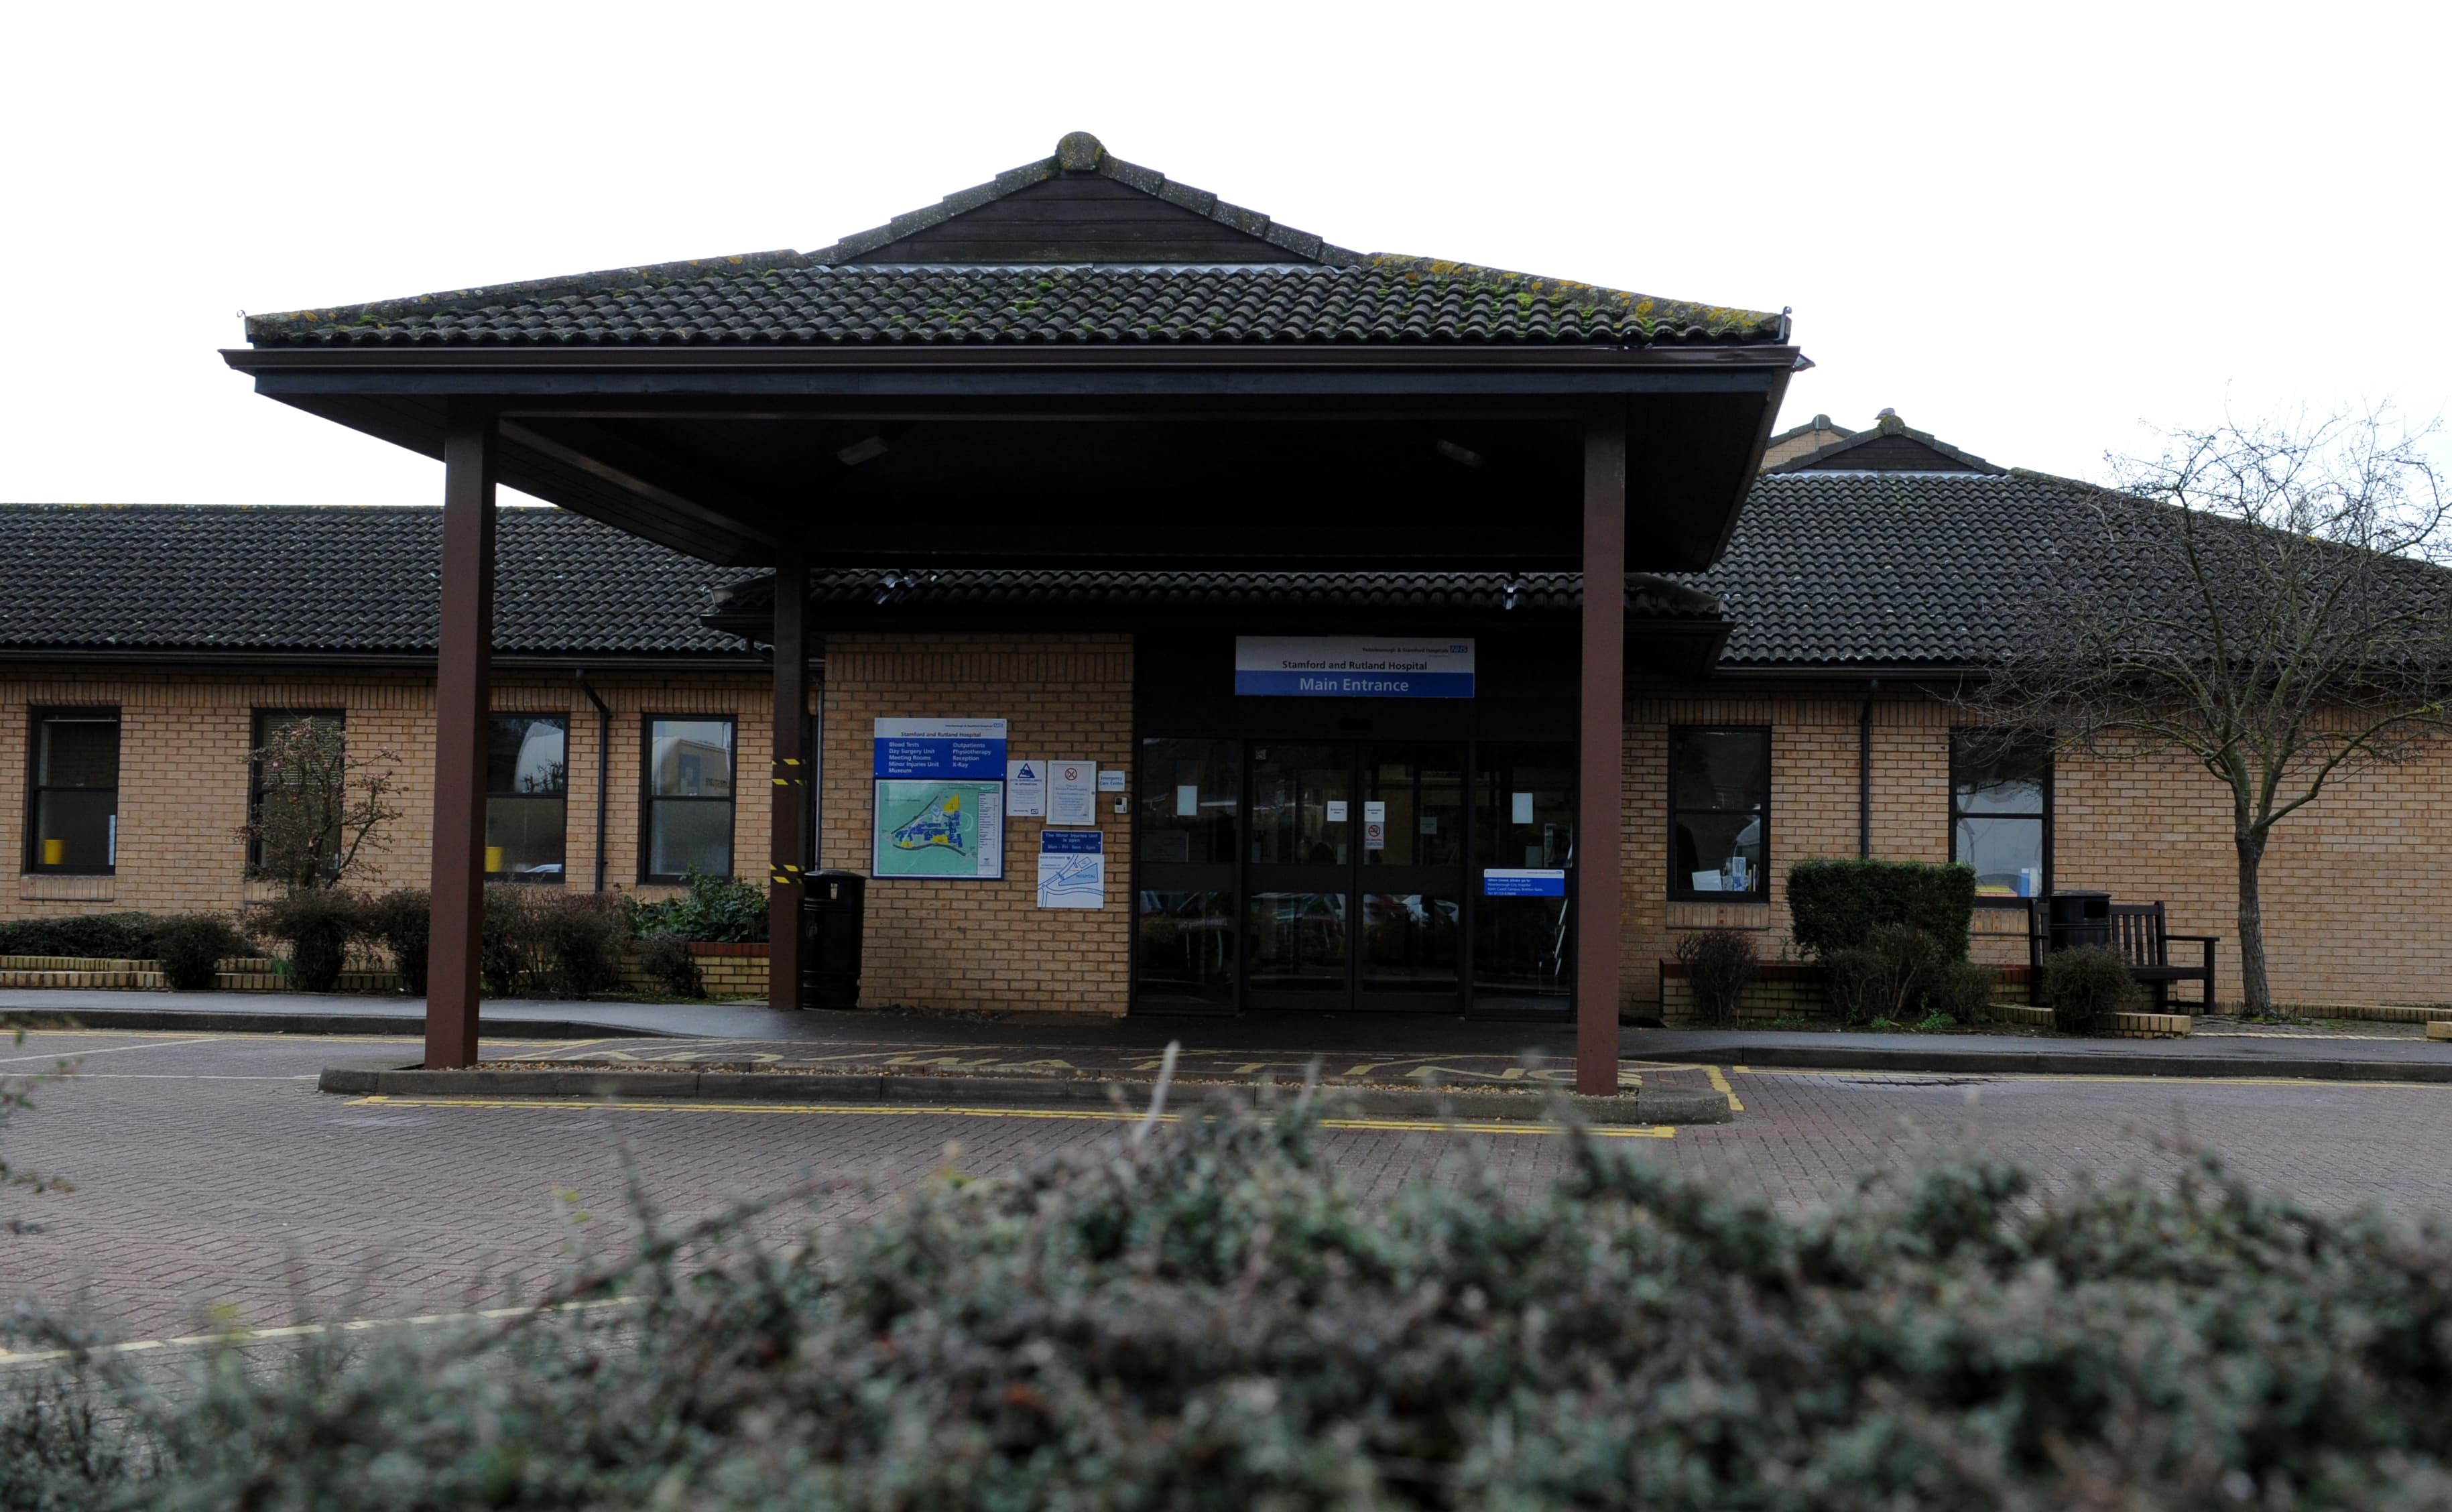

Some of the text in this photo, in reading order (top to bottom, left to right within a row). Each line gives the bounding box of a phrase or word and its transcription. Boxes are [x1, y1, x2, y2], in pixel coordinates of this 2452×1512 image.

[1282, 660, 1427, 672] Stamford and Rutland Hospital
[1300, 678, 1410, 692] Main Entrance
